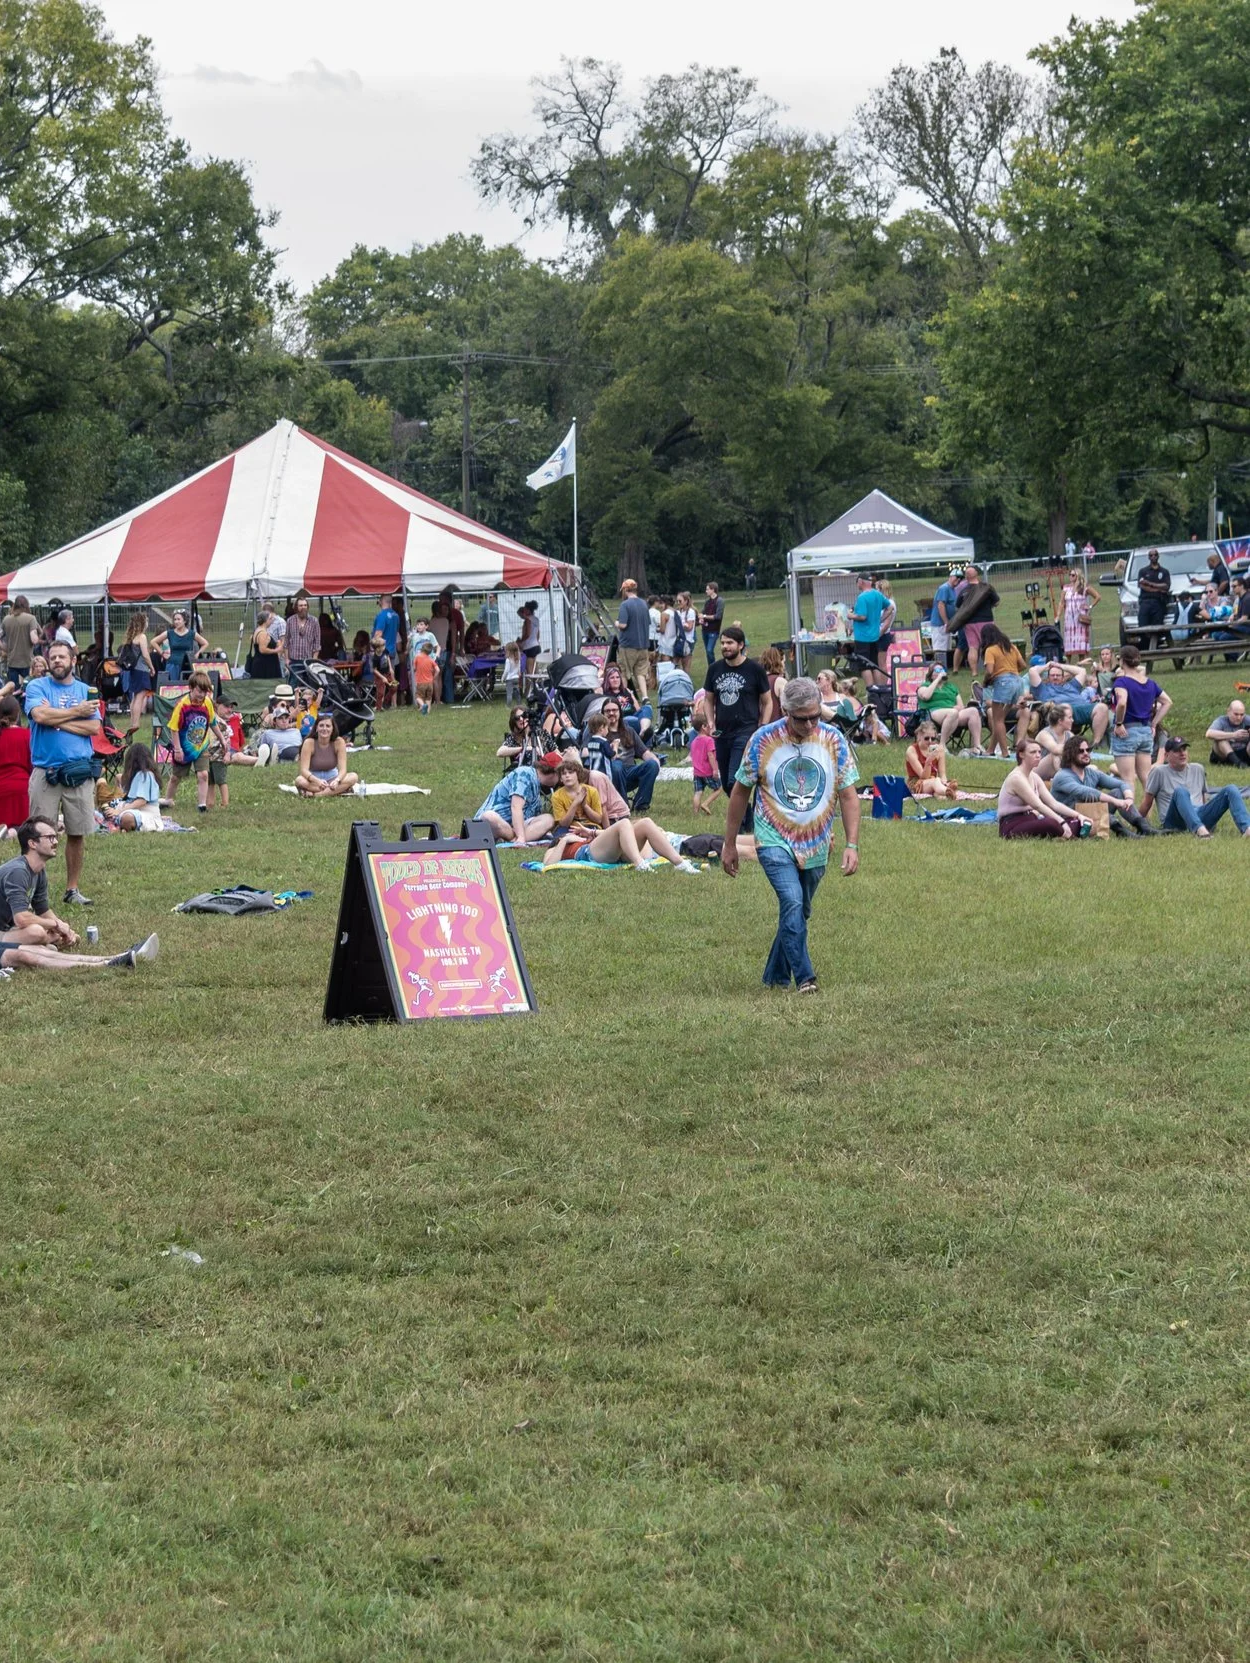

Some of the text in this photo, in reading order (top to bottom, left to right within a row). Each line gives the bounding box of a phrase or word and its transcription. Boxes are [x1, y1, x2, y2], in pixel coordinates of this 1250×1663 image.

[848, 521, 909, 532] DRINK
[440, 858, 487, 888] BREWS
[406, 903, 479, 921] LIGHTNING 100
[470, 946, 482, 956] TN
